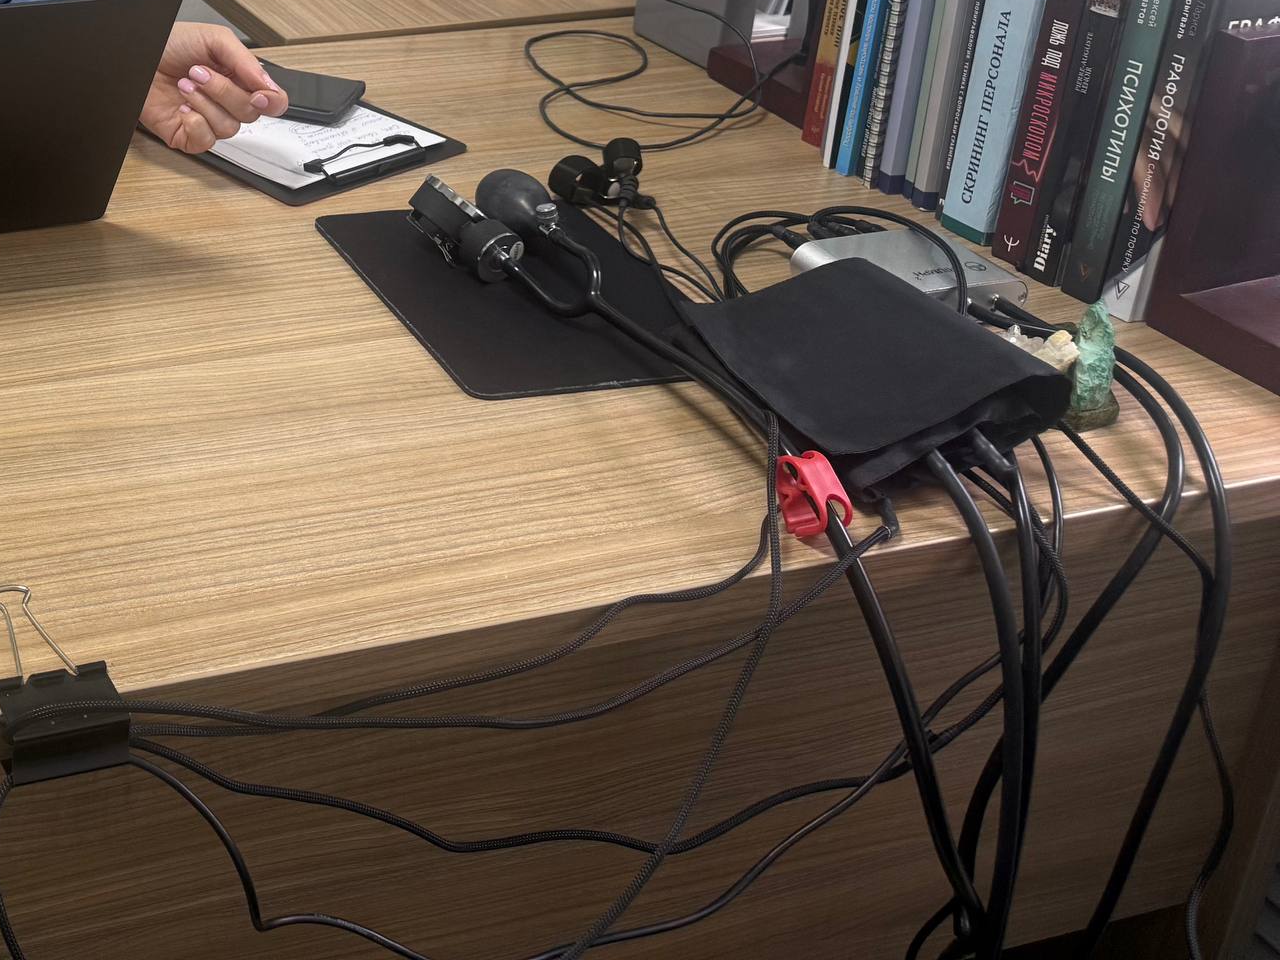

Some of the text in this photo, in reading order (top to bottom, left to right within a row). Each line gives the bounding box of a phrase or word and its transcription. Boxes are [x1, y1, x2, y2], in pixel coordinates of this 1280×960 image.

[961, 114, 989, 204] СКРИНИНГ
[981, 10, 1012, 115] ПЕРСОНАЛА
[1022, 19, 1069, 161] ЛОЖЬ ПОД МИКРОСКОПОМ
[1100, 59, 1143, 183] ПСИХОТИПЫ
[1122, 53, 1186, 273] ГРАФОЛОГИЯ САМОАНАЛИЗ ПО ПОЧЕРКУ
[1033, 223, 1057, 273] Diary
